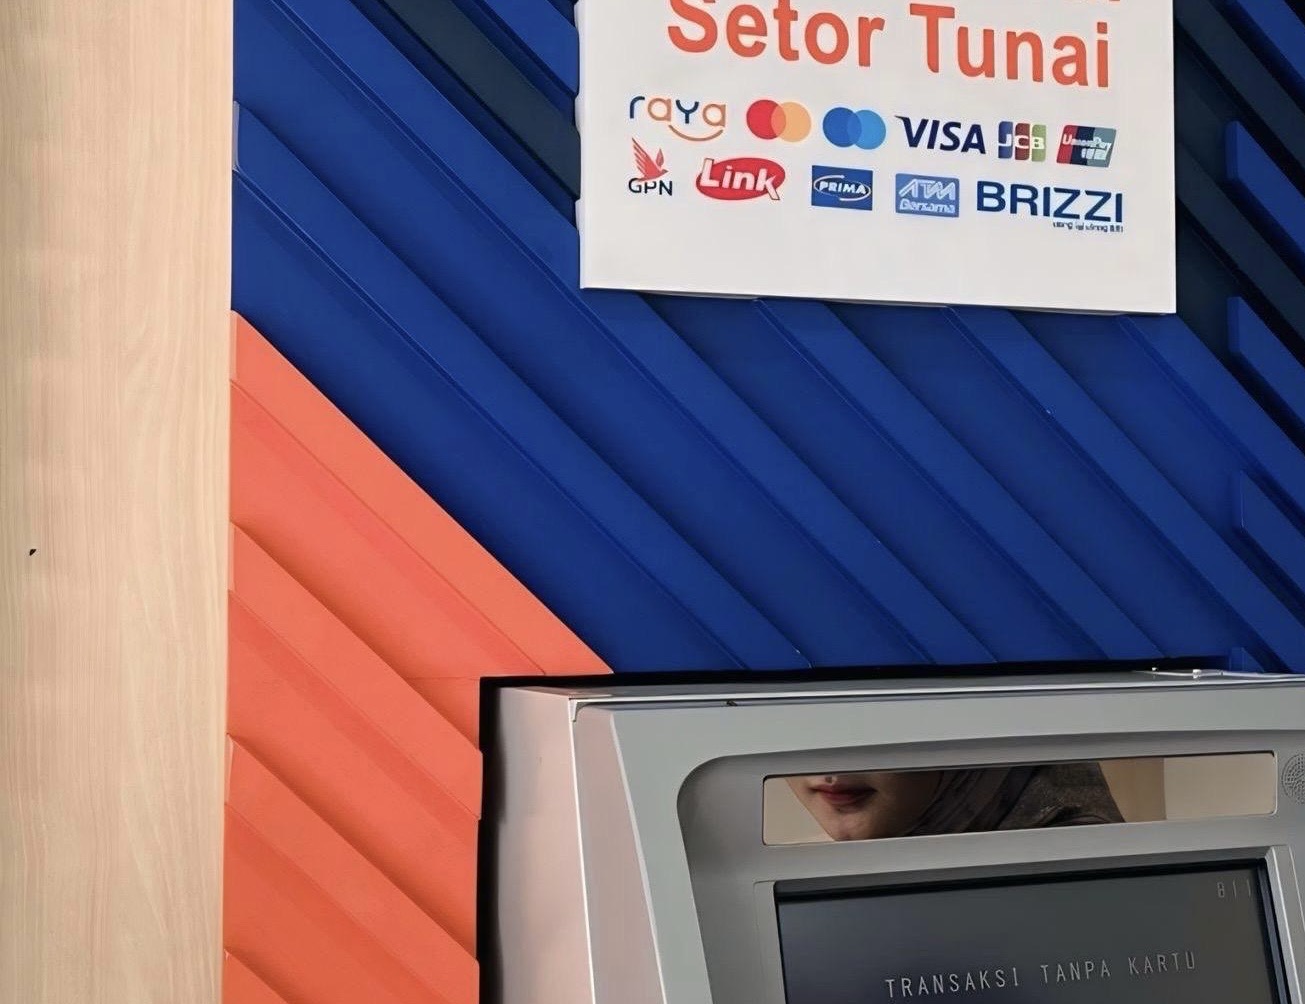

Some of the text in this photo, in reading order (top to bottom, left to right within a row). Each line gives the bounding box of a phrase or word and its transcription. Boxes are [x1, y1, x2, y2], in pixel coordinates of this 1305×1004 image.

[667, 0, 1110, 88] Setor Tunai
[629, 95, 727, 128] raya
[894, 115, 987, 154] VISA
[628, 178, 673, 196] GPN
[700, 158, 781, 201] Link
[818, 181, 870, 196] PRIMA
[898, 178, 957, 200] ATM
[976, 180, 1123, 223] BRIZZI
[885, 950, 1197, 999] TRANSAKSI TANPA KARTU
